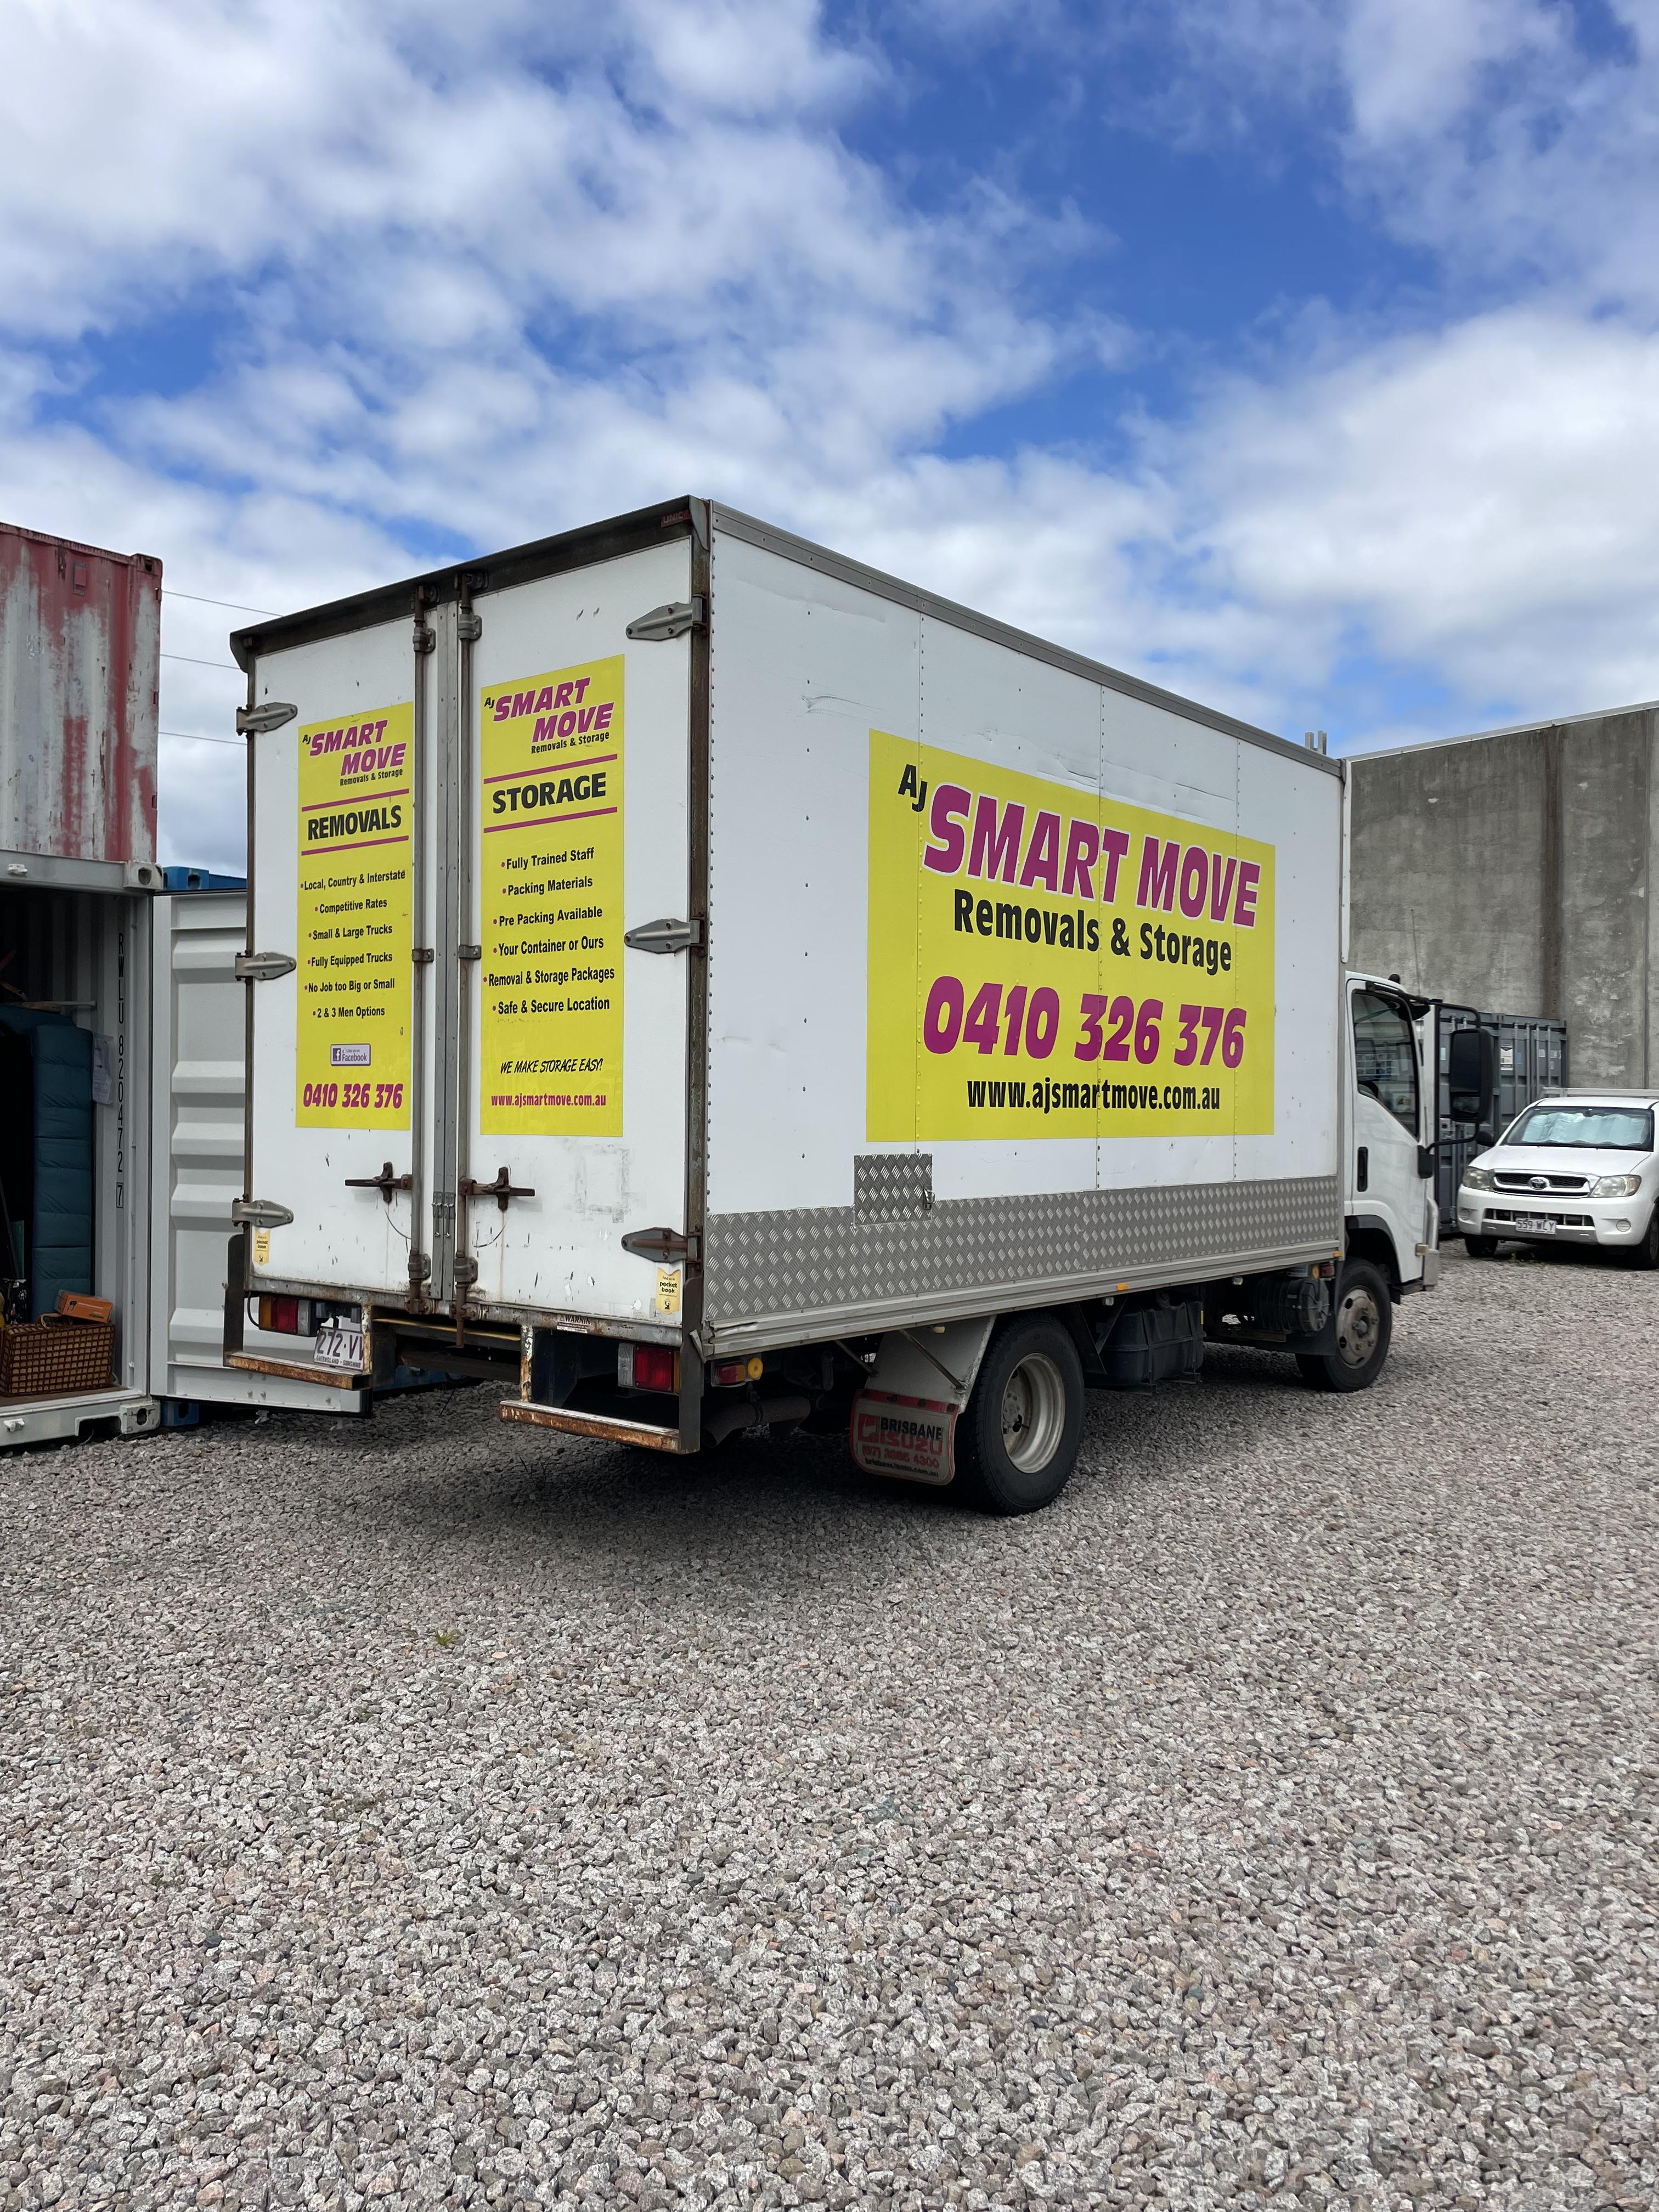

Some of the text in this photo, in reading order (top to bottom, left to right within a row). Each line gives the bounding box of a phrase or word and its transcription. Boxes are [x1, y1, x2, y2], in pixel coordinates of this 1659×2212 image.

[484, 677, 591, 722] AJ SMART
[532, 702, 614, 743] MOVE
[302, 719, 388, 757] AJ SMART
[531, 731, 610, 754] Removals & Storage
[340, 742, 407, 777] MOVE
[340, 768, 403, 786] Removals & Storage
[493, 772, 606, 814] STORAGE
[308, 805, 402, 841] REMOVALS
[898, 764, 1262, 929] AJ SMART MOVE
[506, 847, 595, 871] Fully Trained Staff
[304, 870, 405, 891] Local, Country & Interstate
[507, 876, 593, 896] Packing Materials
[319, 898, 387, 915] Competitive Rates
[499, 906, 603, 927] Pre Packing Available
[313, 923, 393, 940] Small & Large Trucks
[954, 888, 1232, 976] Removals & Storage
[498, 936, 604, 956] Your Container or Ours
[311, 952, 393, 968] Fully Equipped Trucks
[308, 978, 395, 993] No Job too Big or Small
[488, 967, 615, 987] Removal & Storage Packages
[317, 1006, 385, 1019] 2 & 3 Men Options
[498, 996, 610, 1015] Safe & Secure Location
[923, 975, 1247, 1069] 0410 326 376
[342, 1053, 367, 1062] Facebook
[500, 1058, 603, 1074] WE MAKE STORAGE EASY!
[303, 1083, 404, 1109] 0410 326 376
[491, 1093, 606, 1108] www.ajsmartmove.com.au
[967, 1077, 1220, 1114] www.ajsmartmove.com.au
[117, 1184, 123, 1206] 7
[565, 1315, 590, 1324] WARNIN
[881, 1417, 943, 1441] BRISBANE
[879, 1431, 943, 1456] ISUZU
